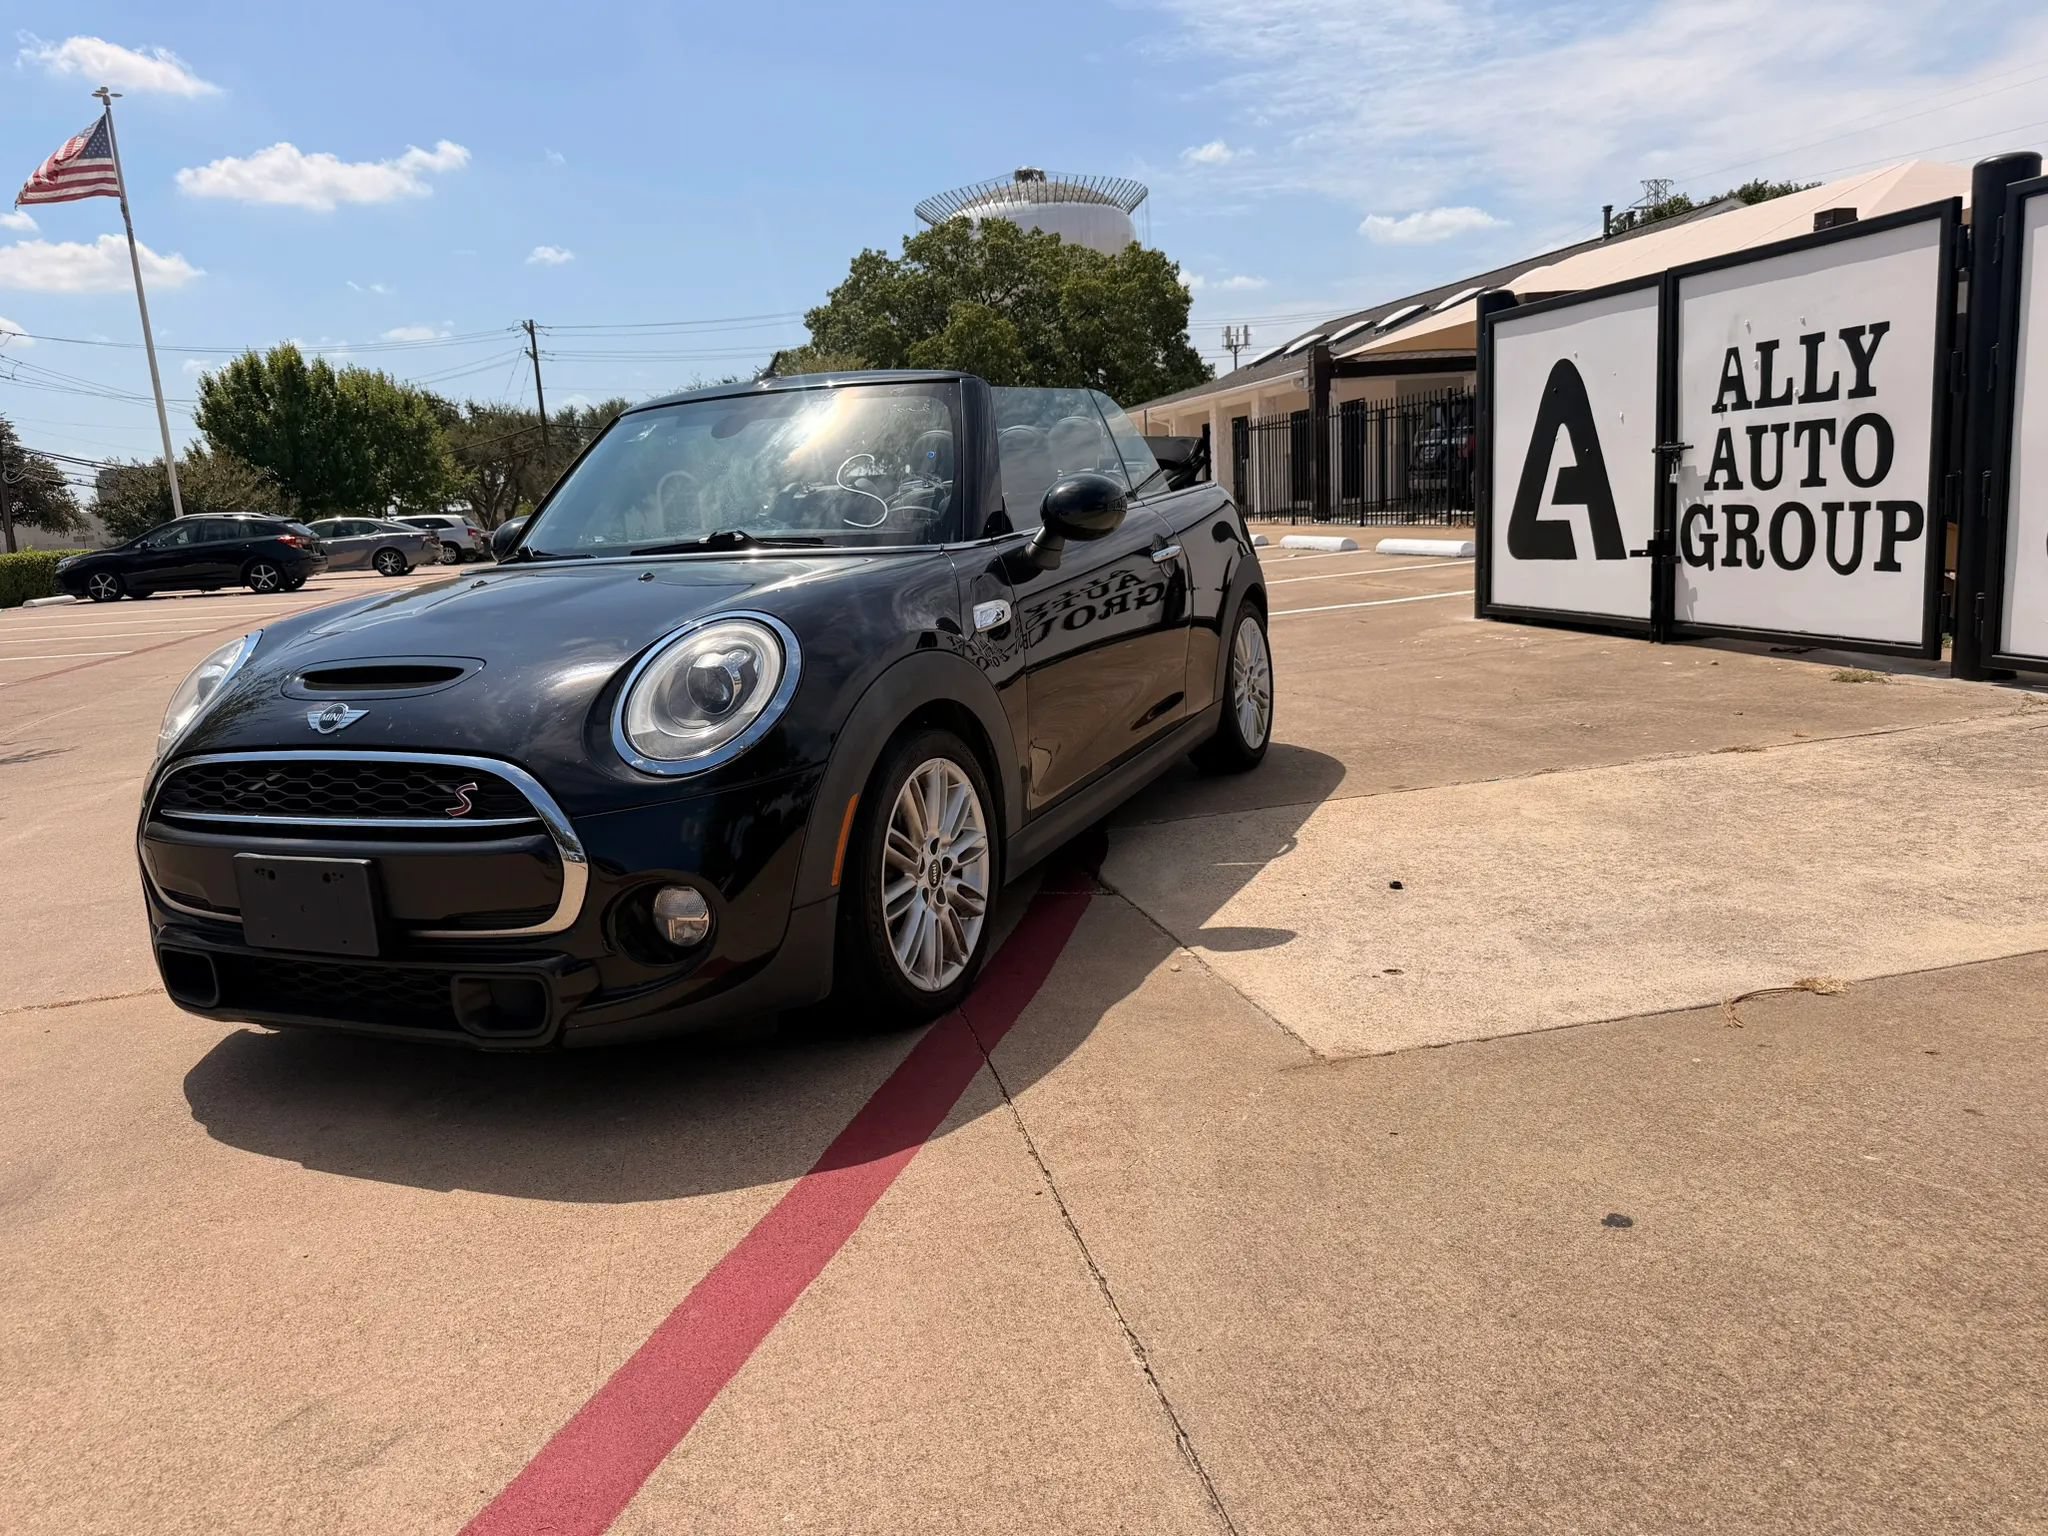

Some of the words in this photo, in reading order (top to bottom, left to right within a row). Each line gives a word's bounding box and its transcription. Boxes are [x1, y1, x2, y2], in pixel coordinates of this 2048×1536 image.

[1711, 320, 1890, 415] ALLY
[1703, 412, 1895, 492] AUTO
[1680, 500, 1925, 576] GROUP
[321, 712, 344, 721] MINI
[444, 781, 479, 817] S
